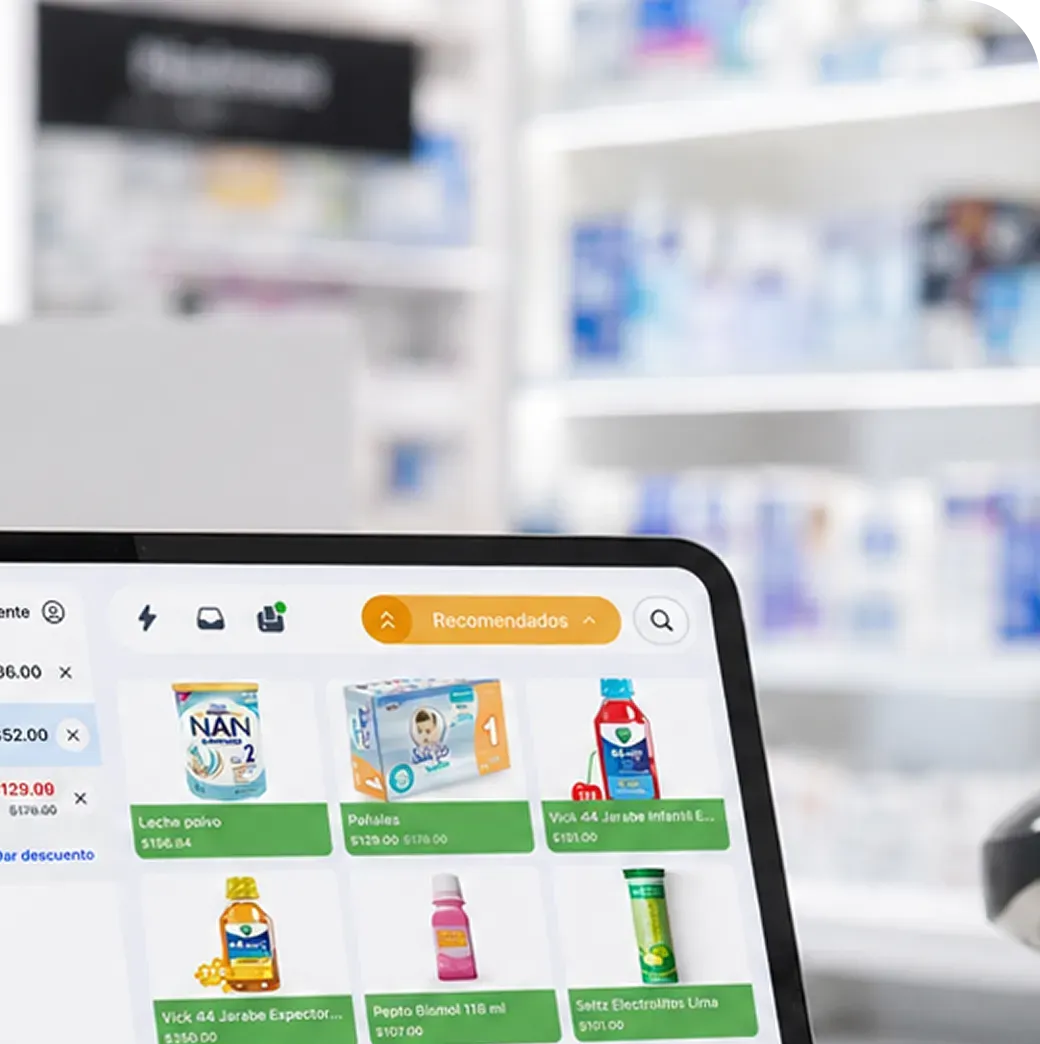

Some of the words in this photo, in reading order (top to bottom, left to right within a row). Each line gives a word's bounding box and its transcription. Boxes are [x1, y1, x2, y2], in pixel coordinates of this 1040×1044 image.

[432, 611, 569, 630] Recomendados
[189, 715, 252, 737] NAN
[481, 715, 499, 747] 1
[243, 743, 256, 763] 2
[20, 848, 96, 862] descuento
[161, 1010, 193, 1025] Vick
[372, 1004, 413, 1019] Pepto
[489, 1002, 507, 1015] ml
